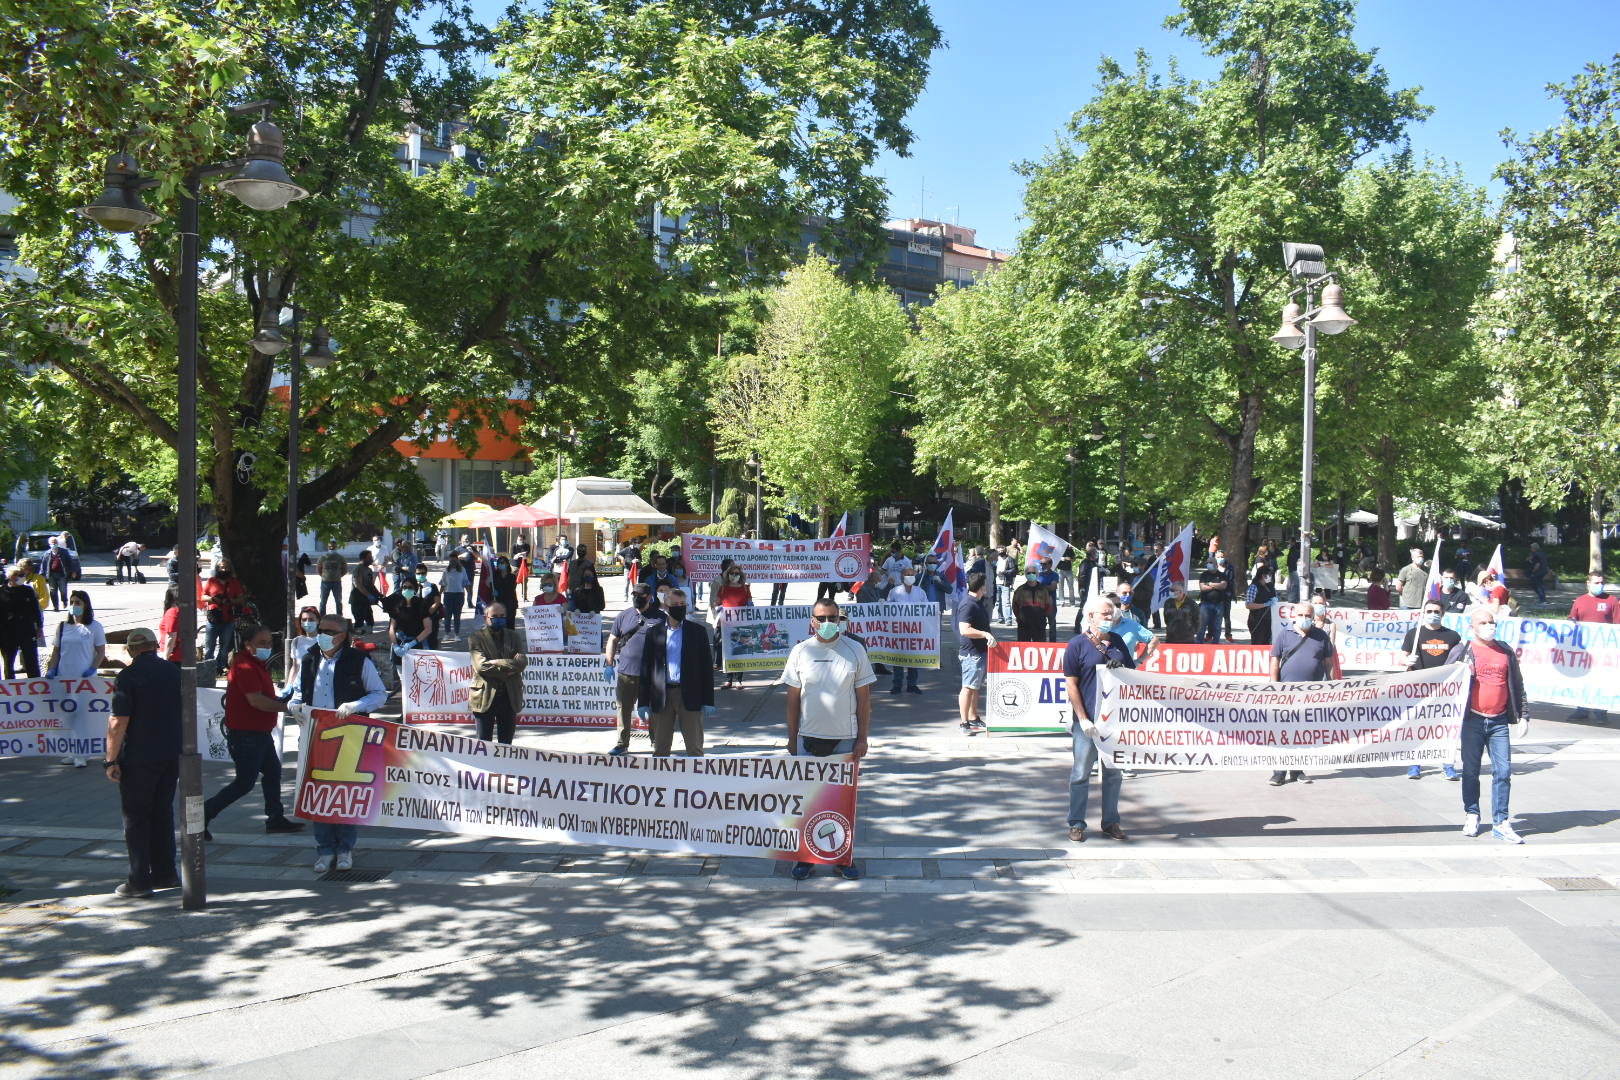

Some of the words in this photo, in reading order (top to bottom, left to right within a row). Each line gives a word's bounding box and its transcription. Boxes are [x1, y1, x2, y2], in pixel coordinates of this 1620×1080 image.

[690, 537, 752, 550] ΖΗΤΩ
[814, 536, 863, 552] ΜΑΗ
[726, 610, 732, 622] Η
[736, 609, 762, 622] ΥΓΕΙΑ
[764, 608, 783, 620] ΔΕΝ
[786, 607, 811, 620] ΕΙΝΑΙ
[868, 605, 882, 616] ΝΑ
[884, 604, 936, 616] ΠΟΥΛΙΕΤΑΙ
[866, 620, 888, 632] ΜΑΣ
[892, 621, 922, 634] ΕΙΝΑΙ
[1520, 620, 1590, 649] ΩΡΑΡΙΟ
[546, 658, 554, 666] &
[556, 657, 600, 668] ΣΤΑΘΕΡΗ
[1146, 648, 1204, 673] 21ου
[59, 679, 98, 694] ΤΑ
[552, 686, 559, 695] &
[562, 686, 600, 696] ΔΩΡΕΑΝ
[1119, 684, 1167, 700] ΜΑΖΙΚΕΣ
[1169, 686, 1244, 703] ΠΡΟΣΛΗΨΕΙΣ
[1245, 693, 1294, 706] ΓΙΑΤΡΩΝ
[1304, 688, 1380, 704] ΝΟΣΗΛΕΥΤΩΝ
[1388, 681, 1463, 699] ΠΡΟΣΩΠΙΚΟΥ
[1195, 678, 1377, 692] ΔΙΕΚΔΙΚΟΥΜΕ
[42, 698, 78, 712] ΤΟ
[562, 700, 582, 710] ΤΗΣ
[1119, 708, 1224, 722] ΜΟΝΙΜΟΠΟΙΗΣΗ
[1228, 708, 1268, 722] ΟΛΩΝ
[1272, 708, 1300, 722] ΤΩΝ
[1304, 706, 1402, 722] ΕΠΙΚΟΥΡΙΚΩΝ
[1406, 703, 1462, 721] ΓΙΑΤΡΩΝ
[412, 713, 452, 721] ΕΝΩΣΗ
[520, 716, 572, 724] ΛΑΡΙΣΑΣ
[574, 716, 615, 725] ΜΕΛΟΣ
[1118, 730, 1214, 746] ΑΠΟΚΛΕΙΣΤΙΚΑ
[1217, 730, 1275, 746] ΔΗΜΟΣΙΑ
[1280, 730, 1290, 745] &
[1293, 729, 1350, 745] ΔΩΡΕΑΝ
[1353, 728, 1391, 744] ΥΓΕΙΑ
[1395, 726, 1414, 742] ΓΙΑ
[1417, 724, 1462, 740] ΟΛΟΥΣ
[396, 728, 488, 757] ΕΝΑΝΤΙΑ
[493, 744, 530, 761] ΣΤΗΝ
[693, 758, 856, 786] ΕΚΜΕΤΑΛΛΕΥΣΗ
[1113, 750, 1218, 766] Ε.Ι.Ν.Κ.Υ.Λ.
[1250, 754, 1278, 766] ΙΑΤΡΩΝ
[1280, 754, 1342, 766] ΝΟΣΗΛΕΥΤΗΡΙΩΝ
[1344, 753, 1356, 764] ΚΑΙ
[1356, 752, 1389, 763] ΚΕΝΤΡΩΝ
[1391, 750, 1415, 761] ΥΓΕΙΑΣ
[302, 782, 374, 818] ΜΑΗ
[386, 768, 412, 782] ΚΑΙ
[415, 771, 451, 788] ΤΟΥΣ
[456, 770, 667, 808] ΙΜΠΕΡΙΑΛΙΣΤΙΚΟΥΣ
[674, 788, 804, 816] ΠΟΛΕΜΟΥΣ
[381, 800, 394, 816] ΜΕ
[397, 796, 462, 822] ΣΥΝΔΙΚΑΤΑ
[465, 808, 482, 824] ΤΩΝ
[486, 805, 538, 828] ΕΡΓΑΤΩΝ
[541, 816, 556, 830] ΚΑΙ
[558, 812, 579, 833] ΟΧΙ
[581, 820, 598, 834] ΤΩΝ
[600, 816, 689, 842] ΚΥΒΕΡΝΗΣΕΩΝ
[690, 828, 704, 842] ΚΑΙ
[706, 830, 723, 844] ΤΩΝ
[725, 824, 800, 852] ΕΡΓΟΔΟΤΩΝ
